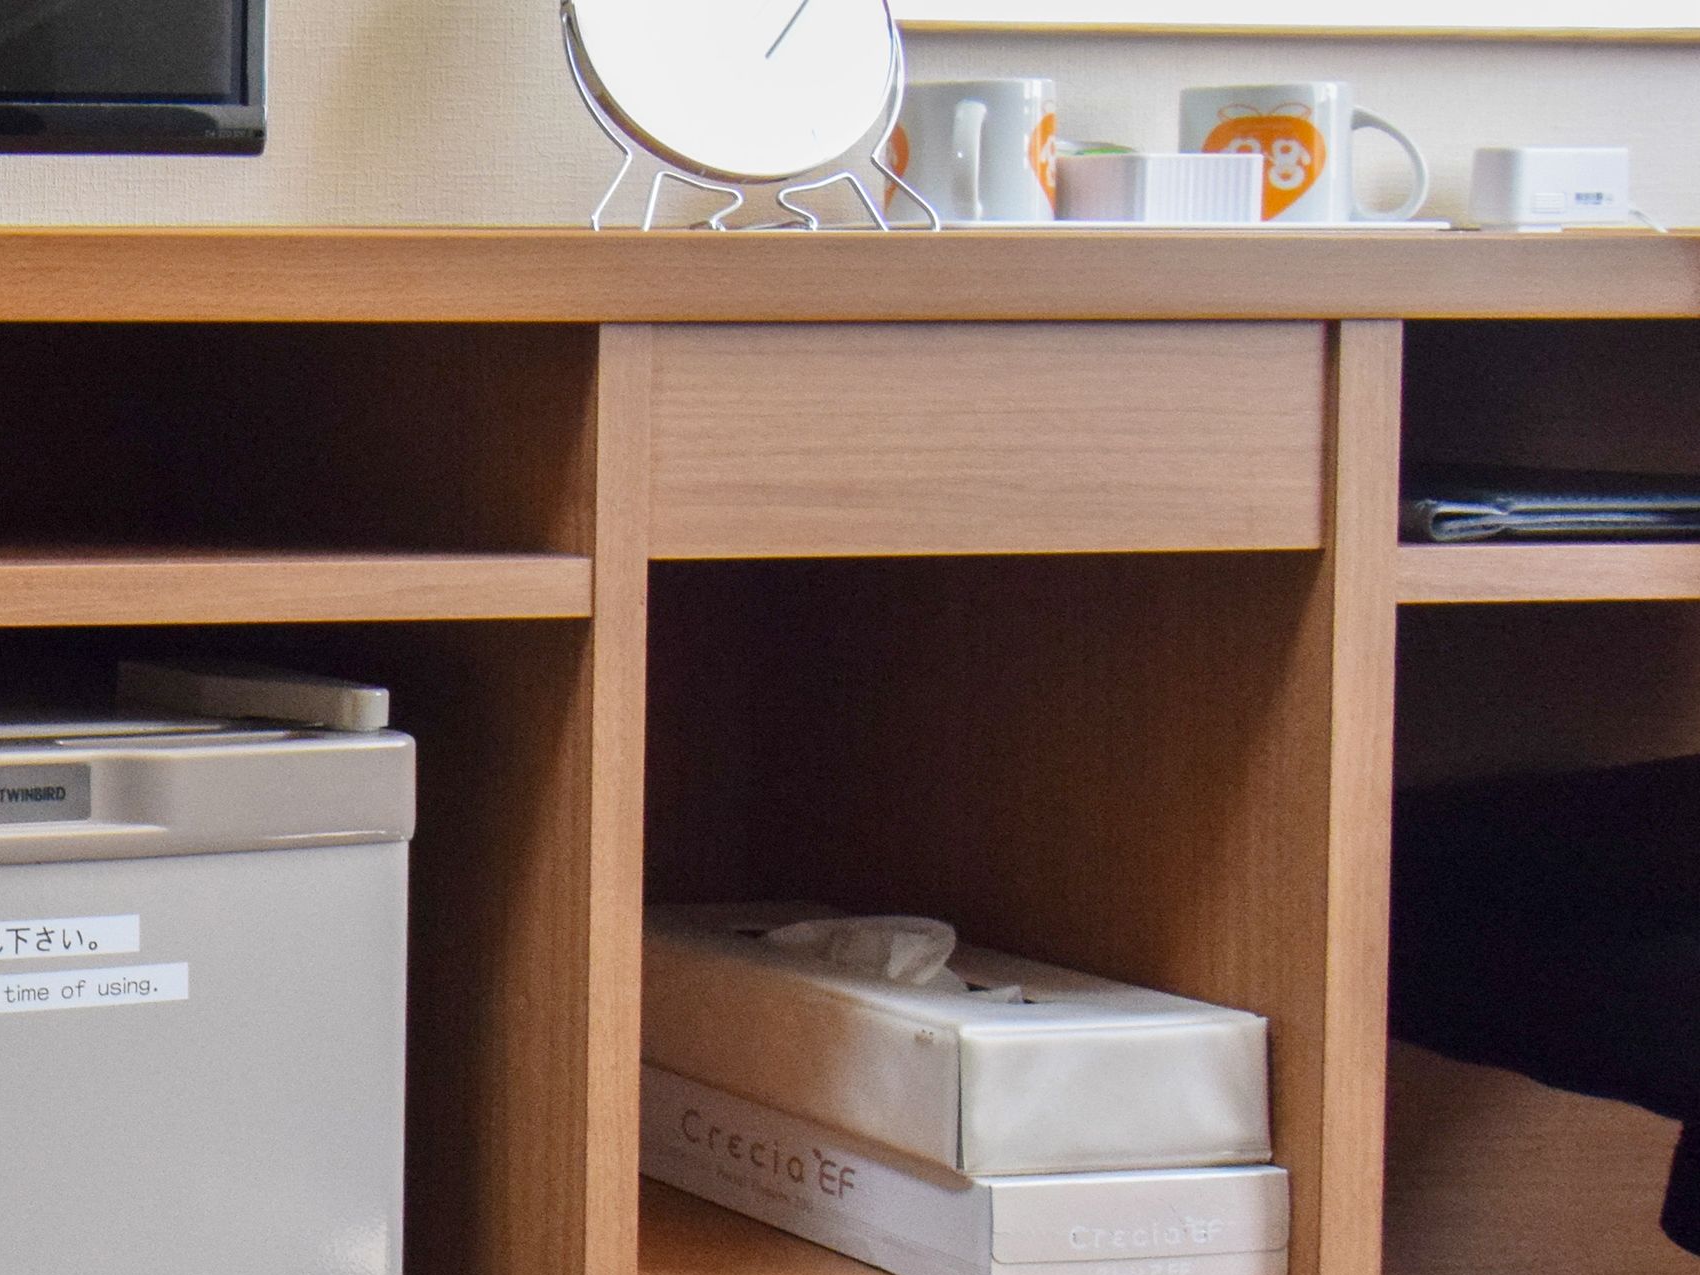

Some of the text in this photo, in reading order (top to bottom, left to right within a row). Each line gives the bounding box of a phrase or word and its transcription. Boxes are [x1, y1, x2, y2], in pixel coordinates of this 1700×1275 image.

[4, 984, 49, 1003] time
[61, 980, 86, 999] of
[98, 977, 159, 996] using.
